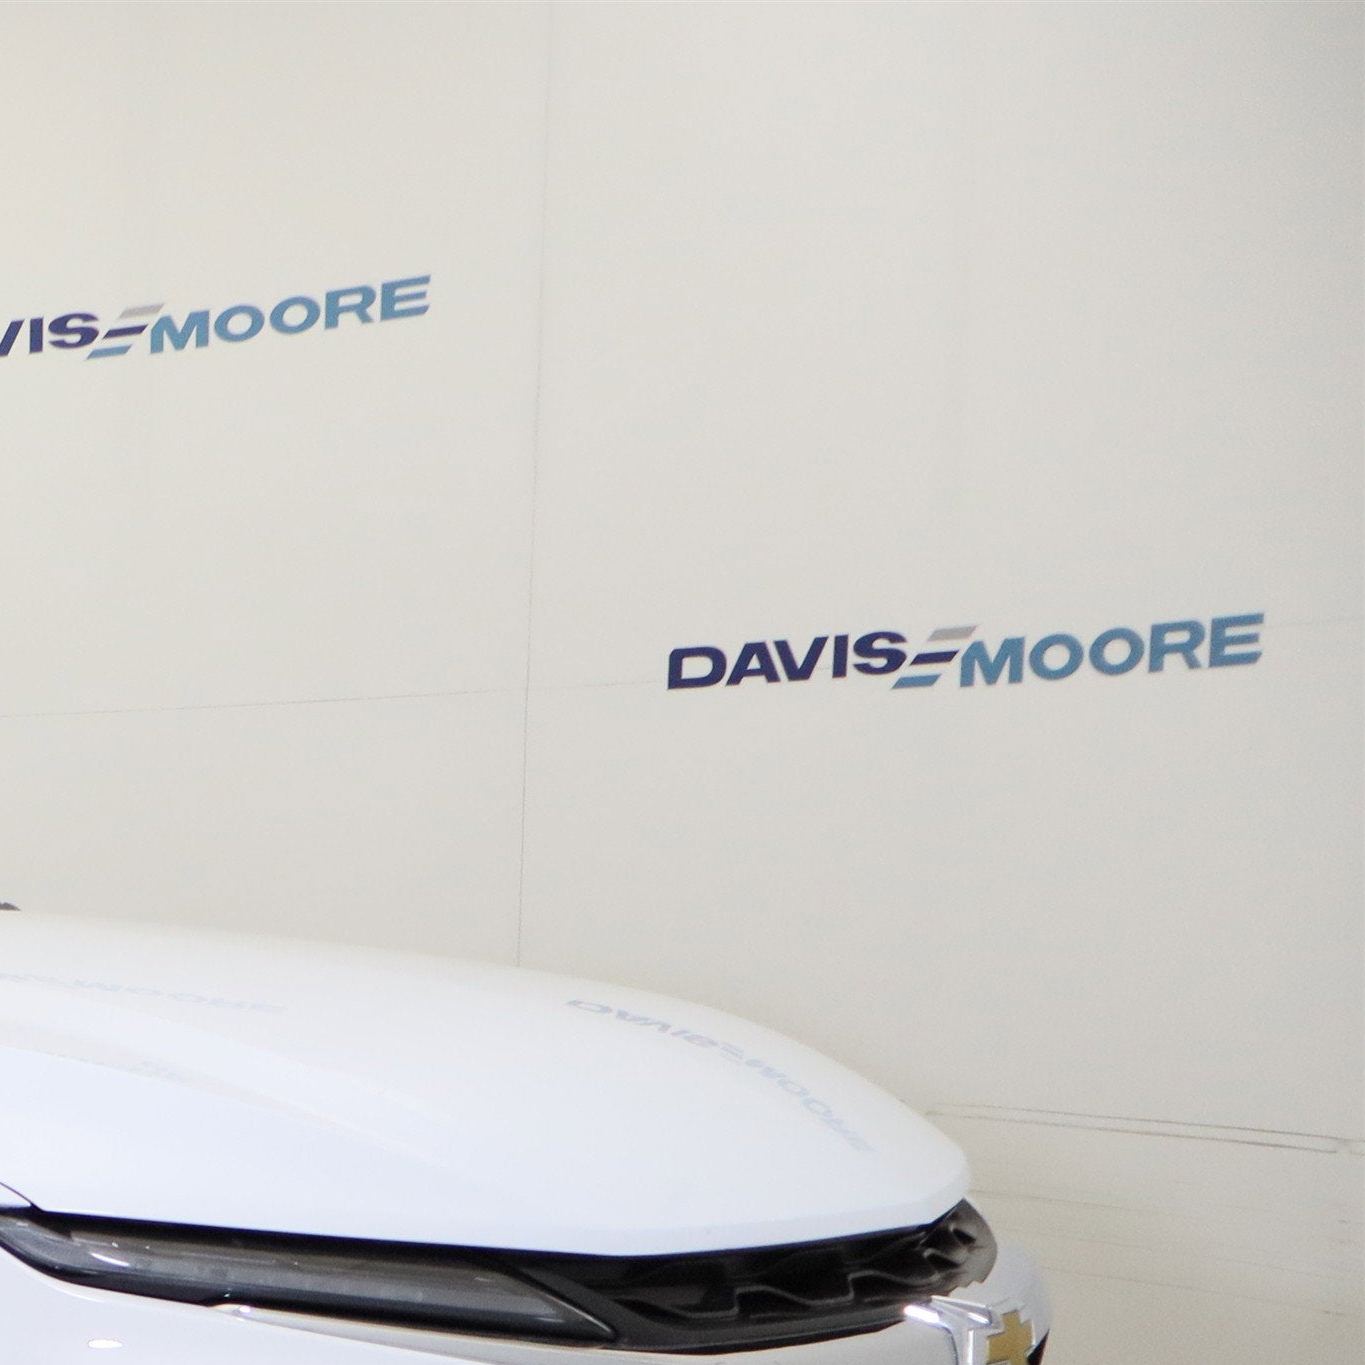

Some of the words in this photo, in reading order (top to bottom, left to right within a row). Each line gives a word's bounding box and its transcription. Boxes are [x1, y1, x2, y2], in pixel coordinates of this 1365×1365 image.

[150, 274, 432, 355] MOORE
[668, 630, 908, 690] DAVIS
[959, 612, 1264, 689] MOORE
